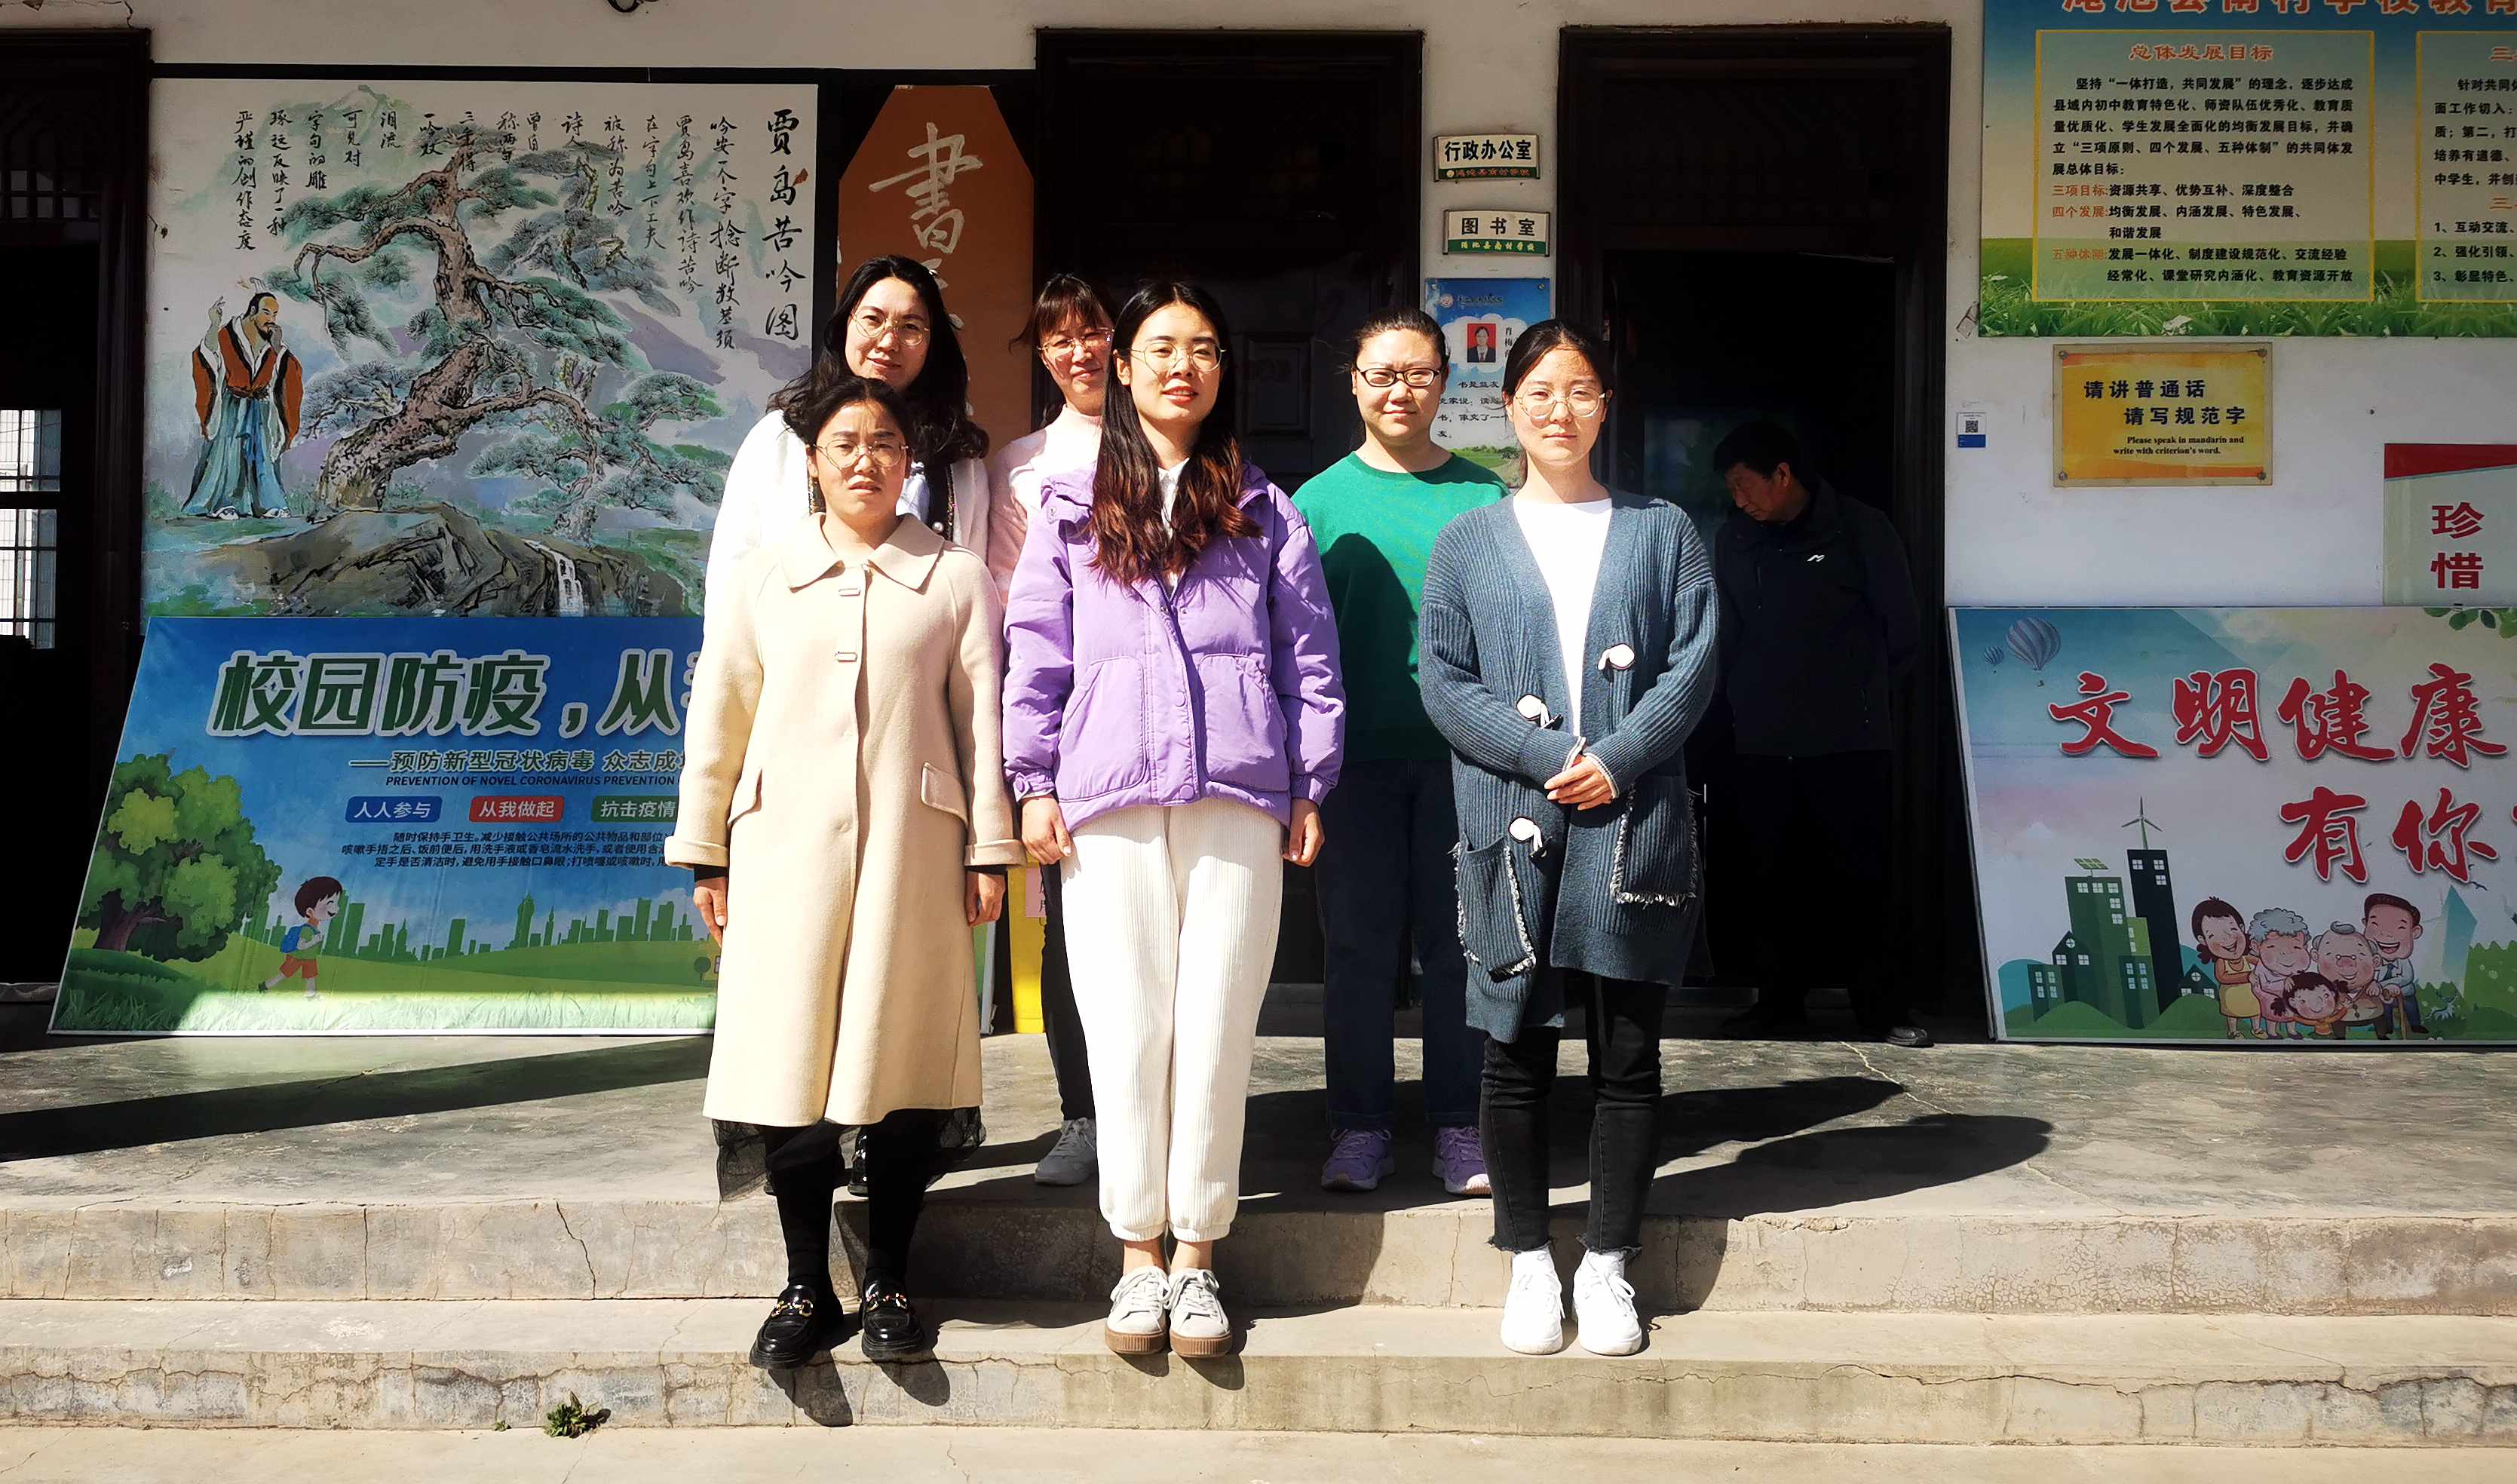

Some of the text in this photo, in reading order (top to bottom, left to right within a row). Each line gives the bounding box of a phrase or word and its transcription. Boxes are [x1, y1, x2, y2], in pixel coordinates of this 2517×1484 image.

[2129, 44, 2274, 61] 总体发展目标
[2489, 47, 2517, 61] 三
[342, 109, 363, 167] 可见对
[561, 112, 585, 147] 诗人
[305, 110, 327, 190] 字句的雕
[1445, 140, 1531, 162] 行政办公室
[231, 111, 256, 250] 严谨的创作态度
[2435, 173, 2517, 186] 中学生，并创
[868, 121, 983, 290] 書
[2490, 198, 2517, 210] 三
[762, 109, 807, 341] 贾岛苦吟图
[1461, 216, 1535, 236] 图书室
[2109, 227, 2162, 239] 和谐发展
[2084, 380, 2206, 398] 请讲普通话
[2124, 406, 2246, 425] 请写规范字
[2154, 437, 2176, 446] speak
[2431, 501, 2484, 589] 珍惜
[206, 648, 700, 737] 校园防疫，从
[2048, 662, 2509, 768] 文明健康
[602, 750, 685, 772] 众志成
[386, 776, 675, 786] PREVENTION OF NOVEL CORONAVIRUS PREVENTION
[354, 802, 431, 818] 人人参与
[478, 801, 556, 818] 从我做起
[600, 801, 676, 818] 抗击疫情
[2279, 785, 2517, 883] 有你
